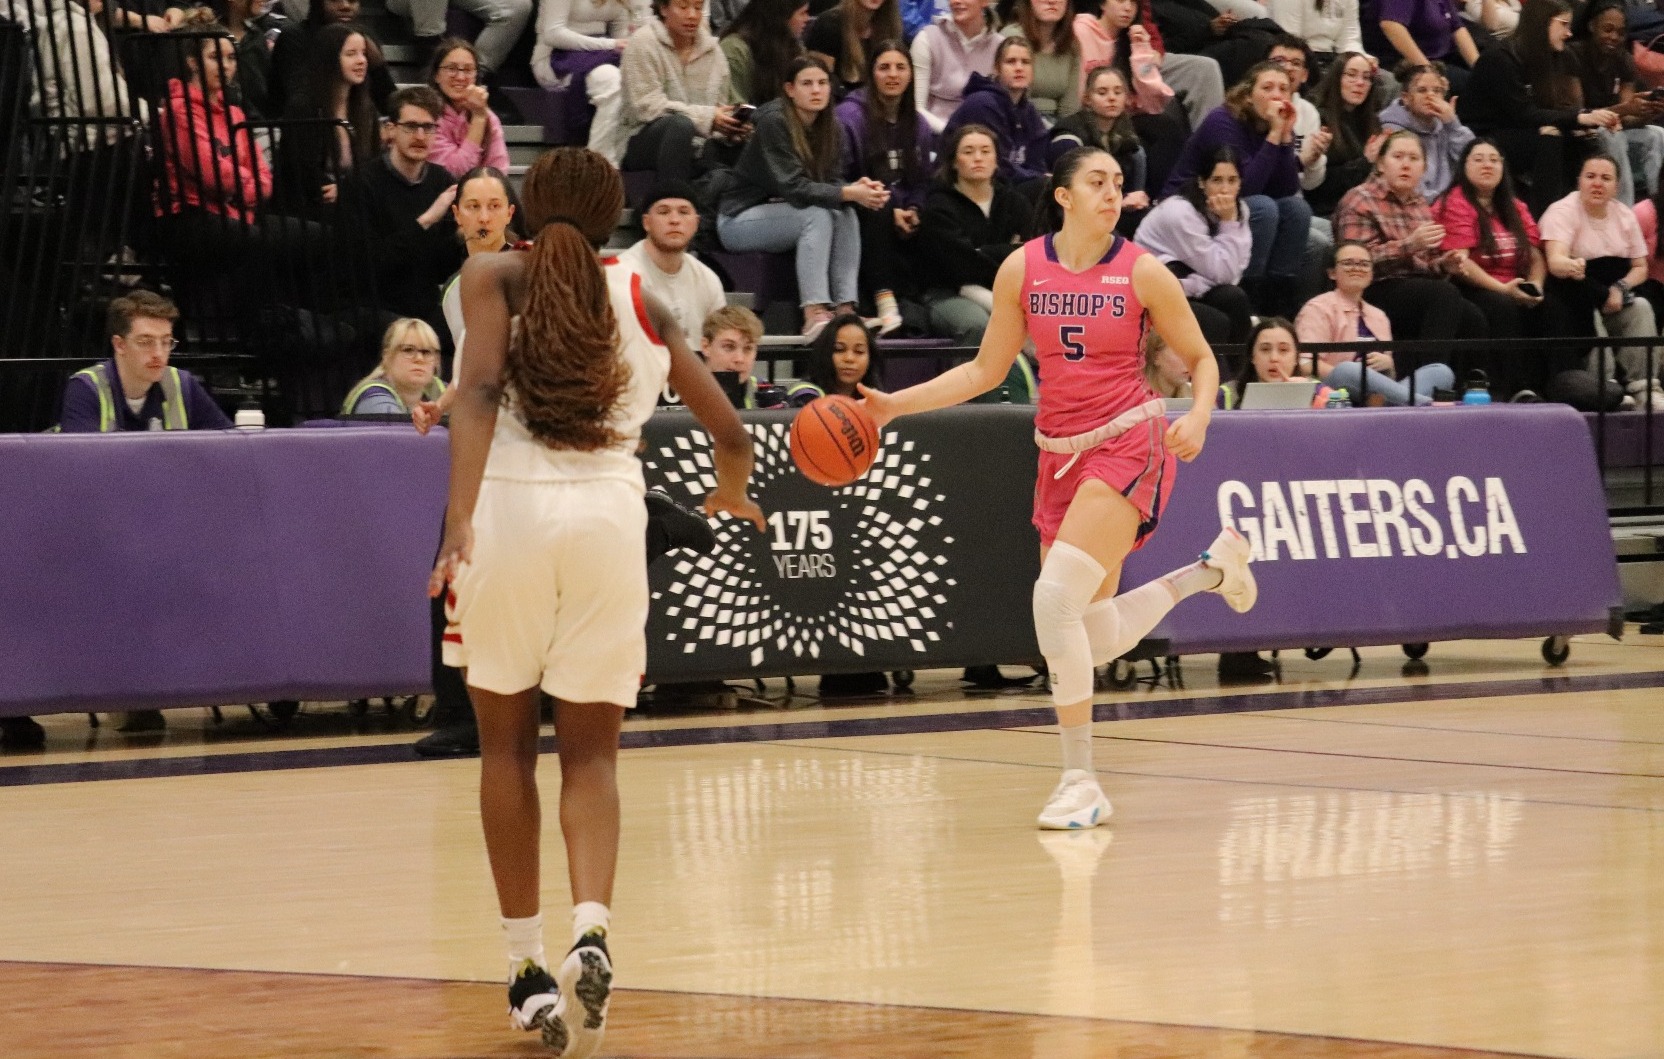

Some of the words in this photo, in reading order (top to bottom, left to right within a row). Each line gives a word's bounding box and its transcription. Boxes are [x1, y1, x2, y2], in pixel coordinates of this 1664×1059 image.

[1029, 292, 1126, 318] BISHOP'S
[1059, 324, 1085, 362] 5
[767, 510, 834, 551] 175
[1217, 475, 1528, 563] GAITERS.CA
[772, 553, 837, 579] YEARS
